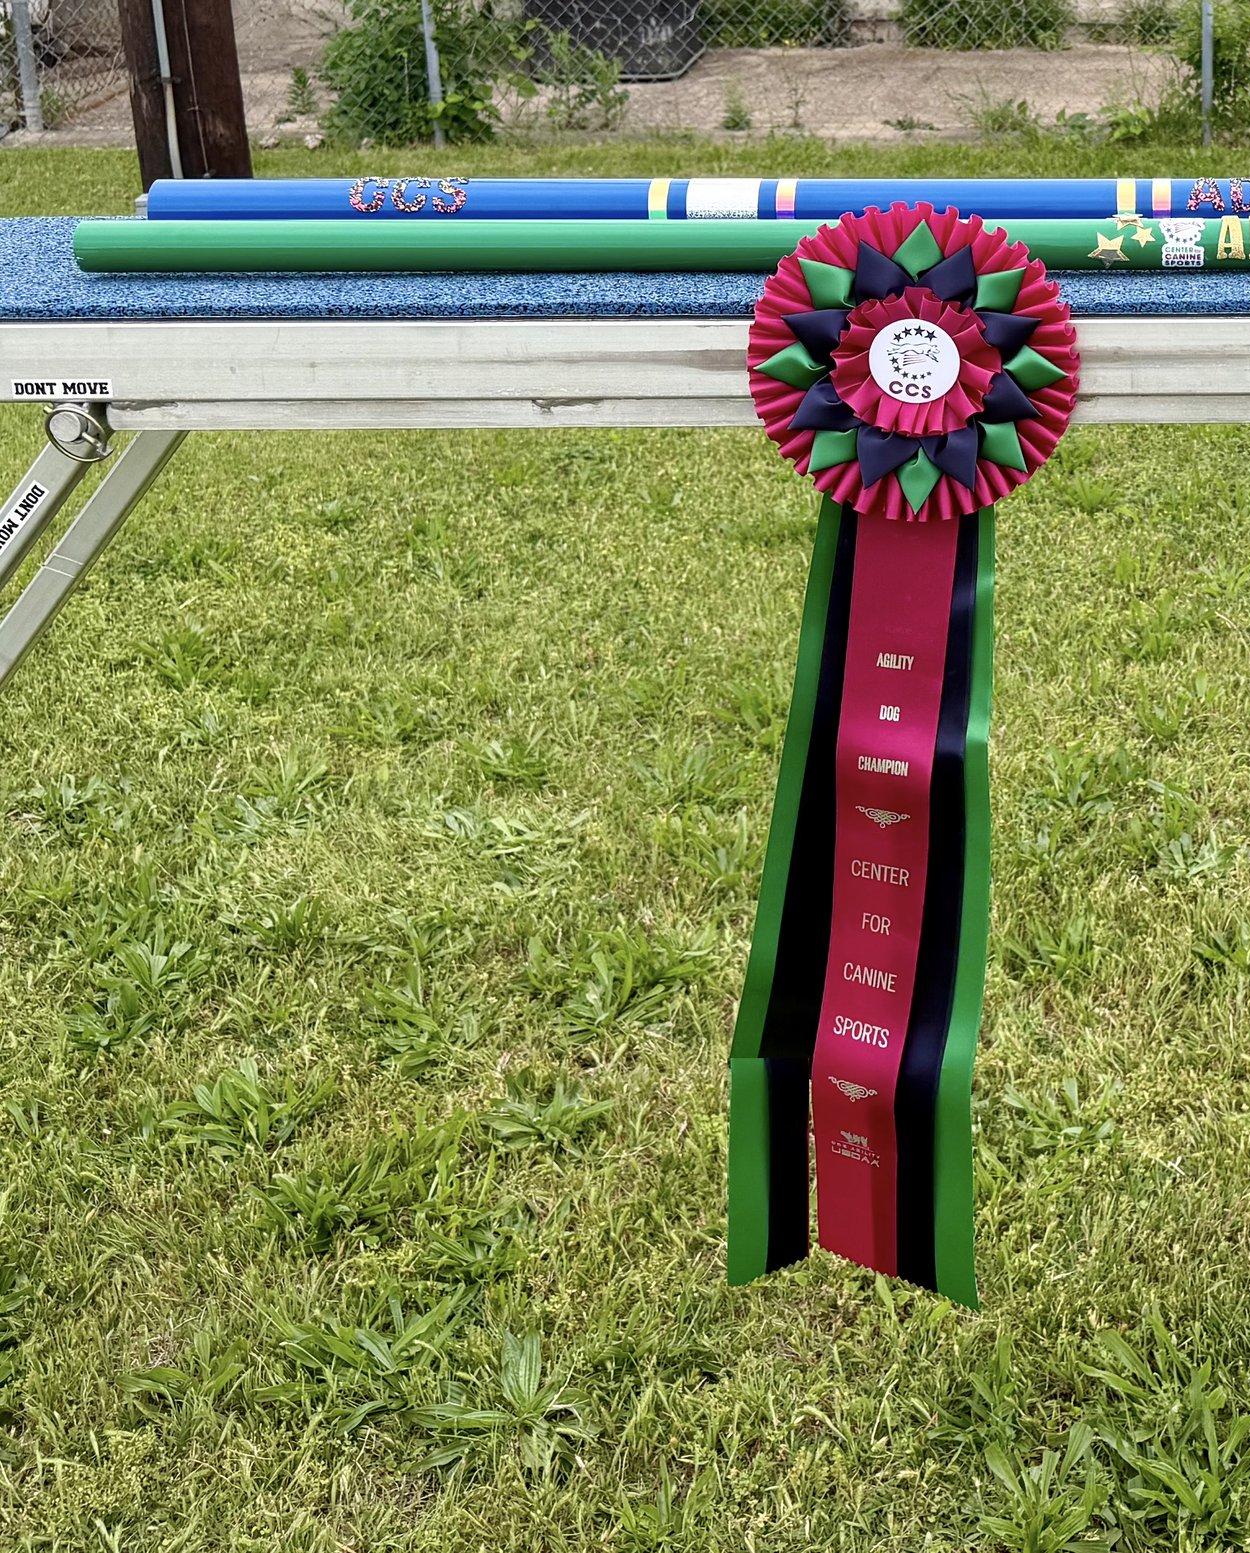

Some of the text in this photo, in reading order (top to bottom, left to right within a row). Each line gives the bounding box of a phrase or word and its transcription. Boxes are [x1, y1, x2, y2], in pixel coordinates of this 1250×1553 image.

[350, 176, 469, 213] CCS
[14, 382, 109, 395] DONT MOVE
[888, 380, 932, 399] CCS
[0, 484, 46, 550] DONT MO
[876, 652, 914, 670] AGILITY
[879, 705, 900, 722] DOG
[857, 756, 909, 777] CHAMPION
[851, 859, 910, 887] CENTER
[861, 912, 891, 936] FOR
[843, 962, 898, 993] CANINE
[833, 1015, 890, 1049] SPORTS
